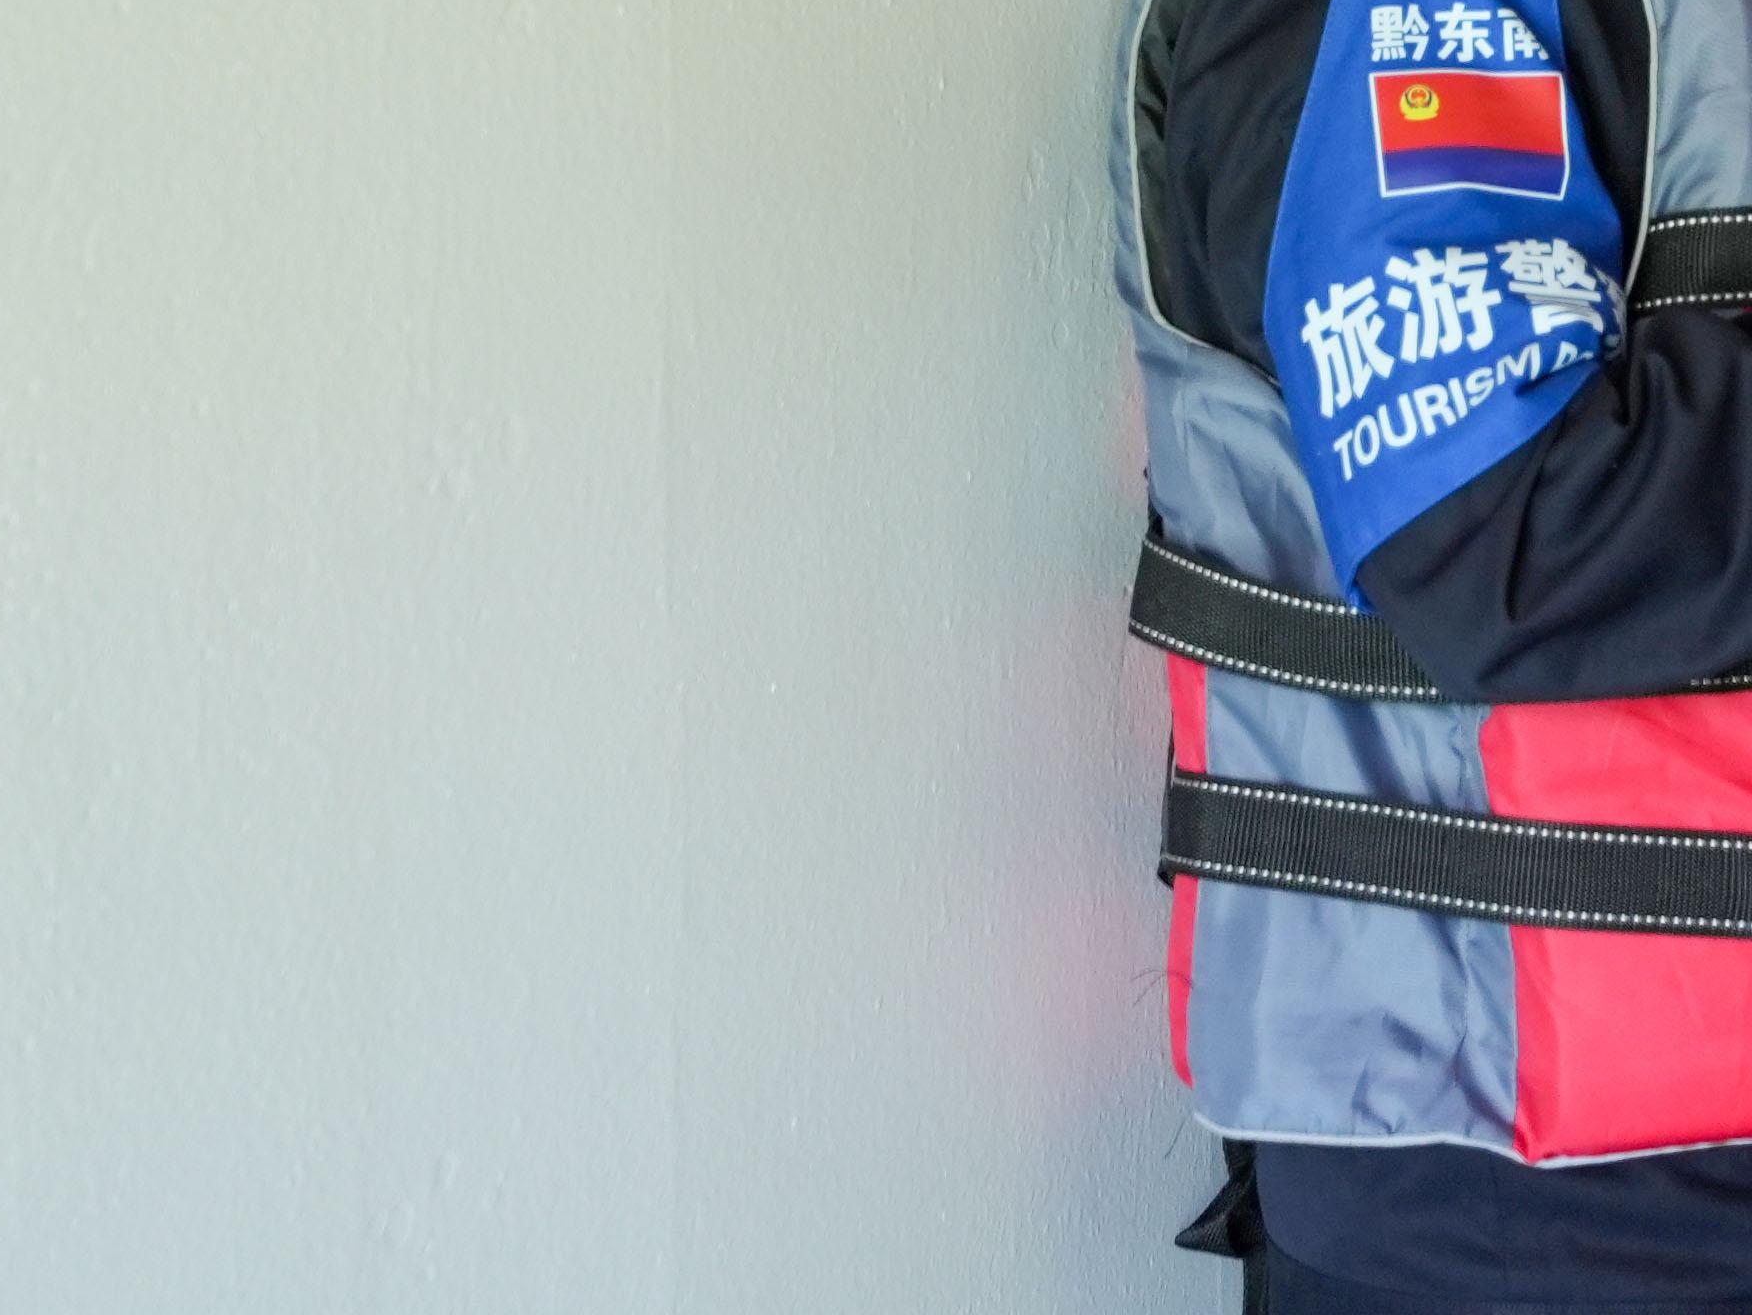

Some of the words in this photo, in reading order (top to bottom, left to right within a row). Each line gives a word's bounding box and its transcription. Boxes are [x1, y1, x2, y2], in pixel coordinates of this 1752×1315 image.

[1301, 238, 1627, 420] 旅游警
[1333, 341, 1543, 482] TOURISM
